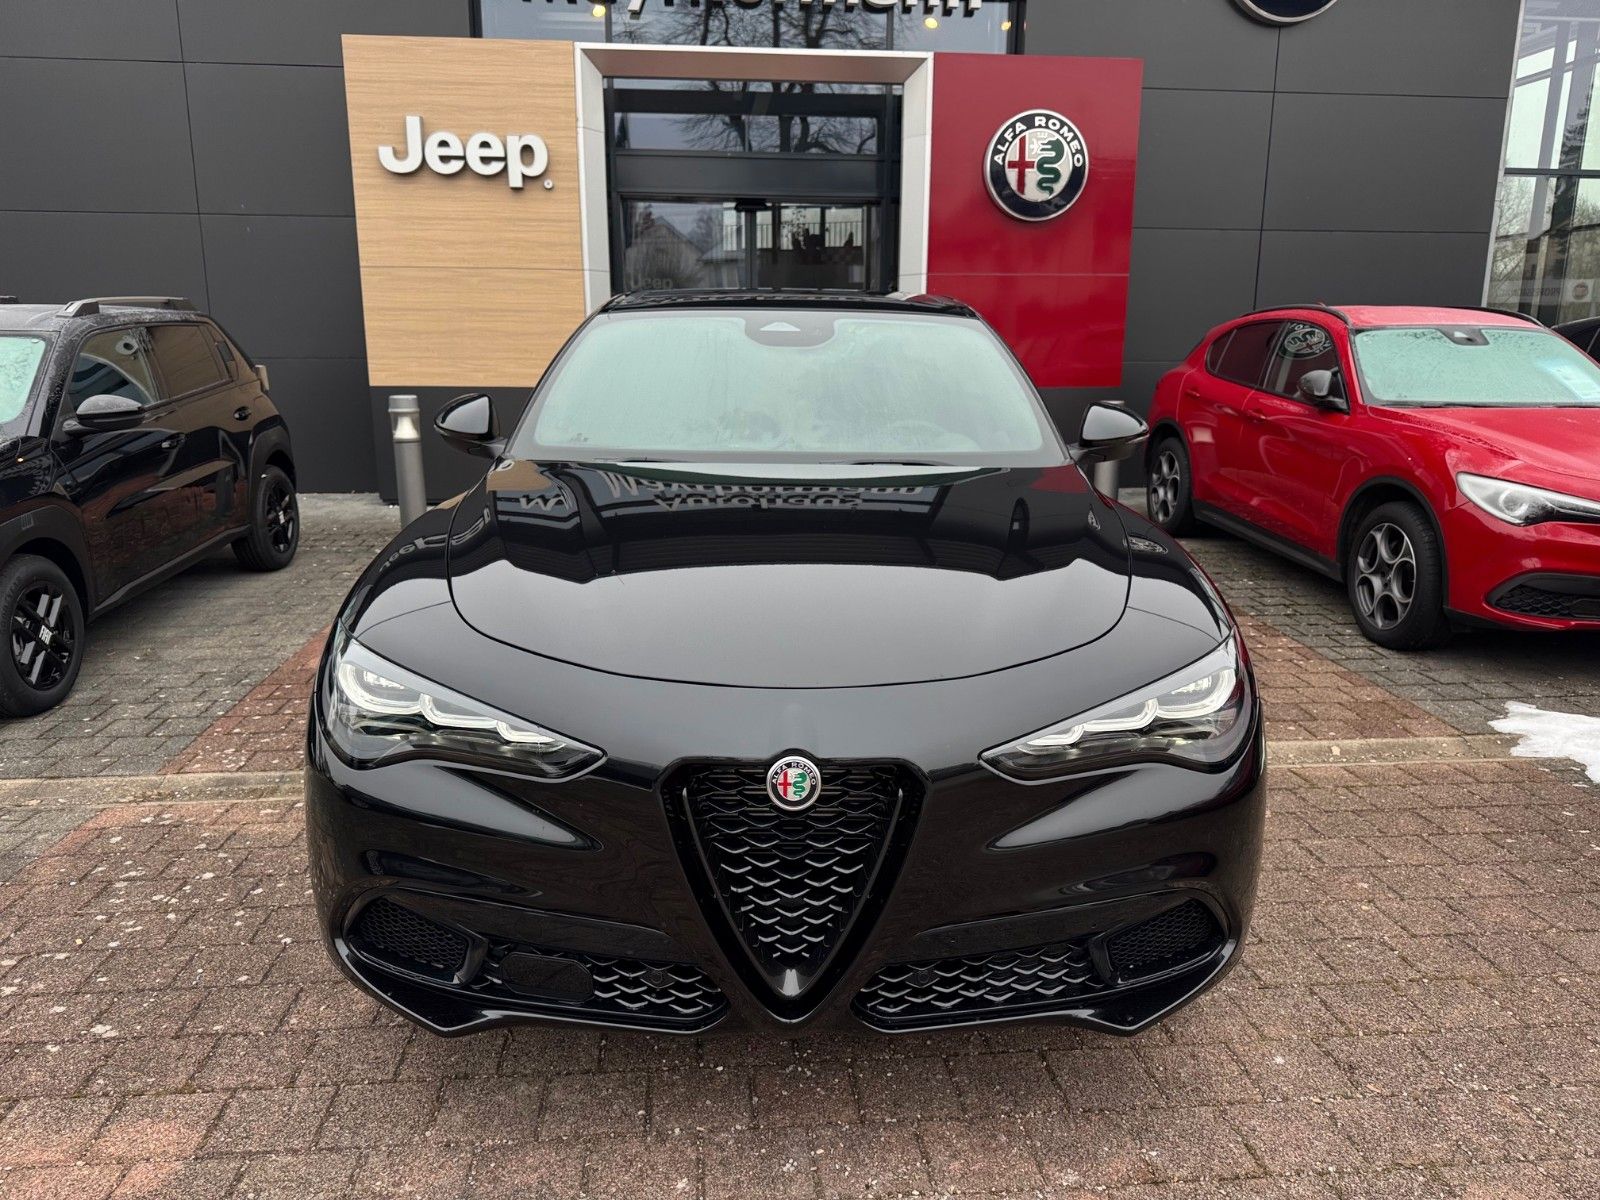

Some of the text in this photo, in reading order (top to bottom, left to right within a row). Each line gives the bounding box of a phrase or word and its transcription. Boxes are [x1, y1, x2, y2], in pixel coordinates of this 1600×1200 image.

[378, 115, 549, 188] Jeep
[993, 116, 1084, 167] ALFA ROMEO
[772, 762, 816, 785] ALFA ROMEO
